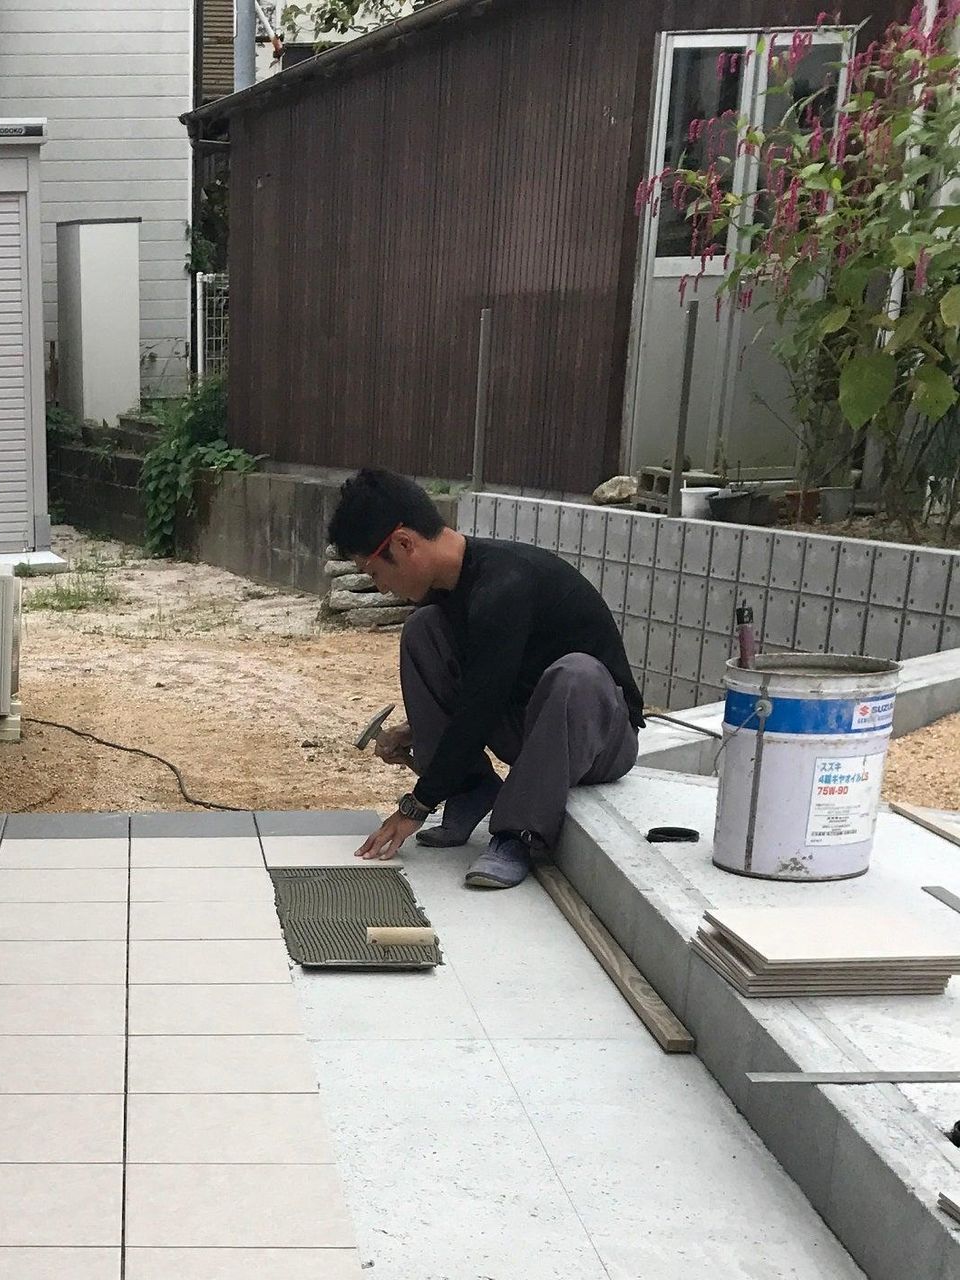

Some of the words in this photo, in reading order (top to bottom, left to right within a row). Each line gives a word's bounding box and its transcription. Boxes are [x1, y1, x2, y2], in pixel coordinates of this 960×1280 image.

[820, 762, 842, 772] スズキ
[817, 786, 848, 795] 75W-90
